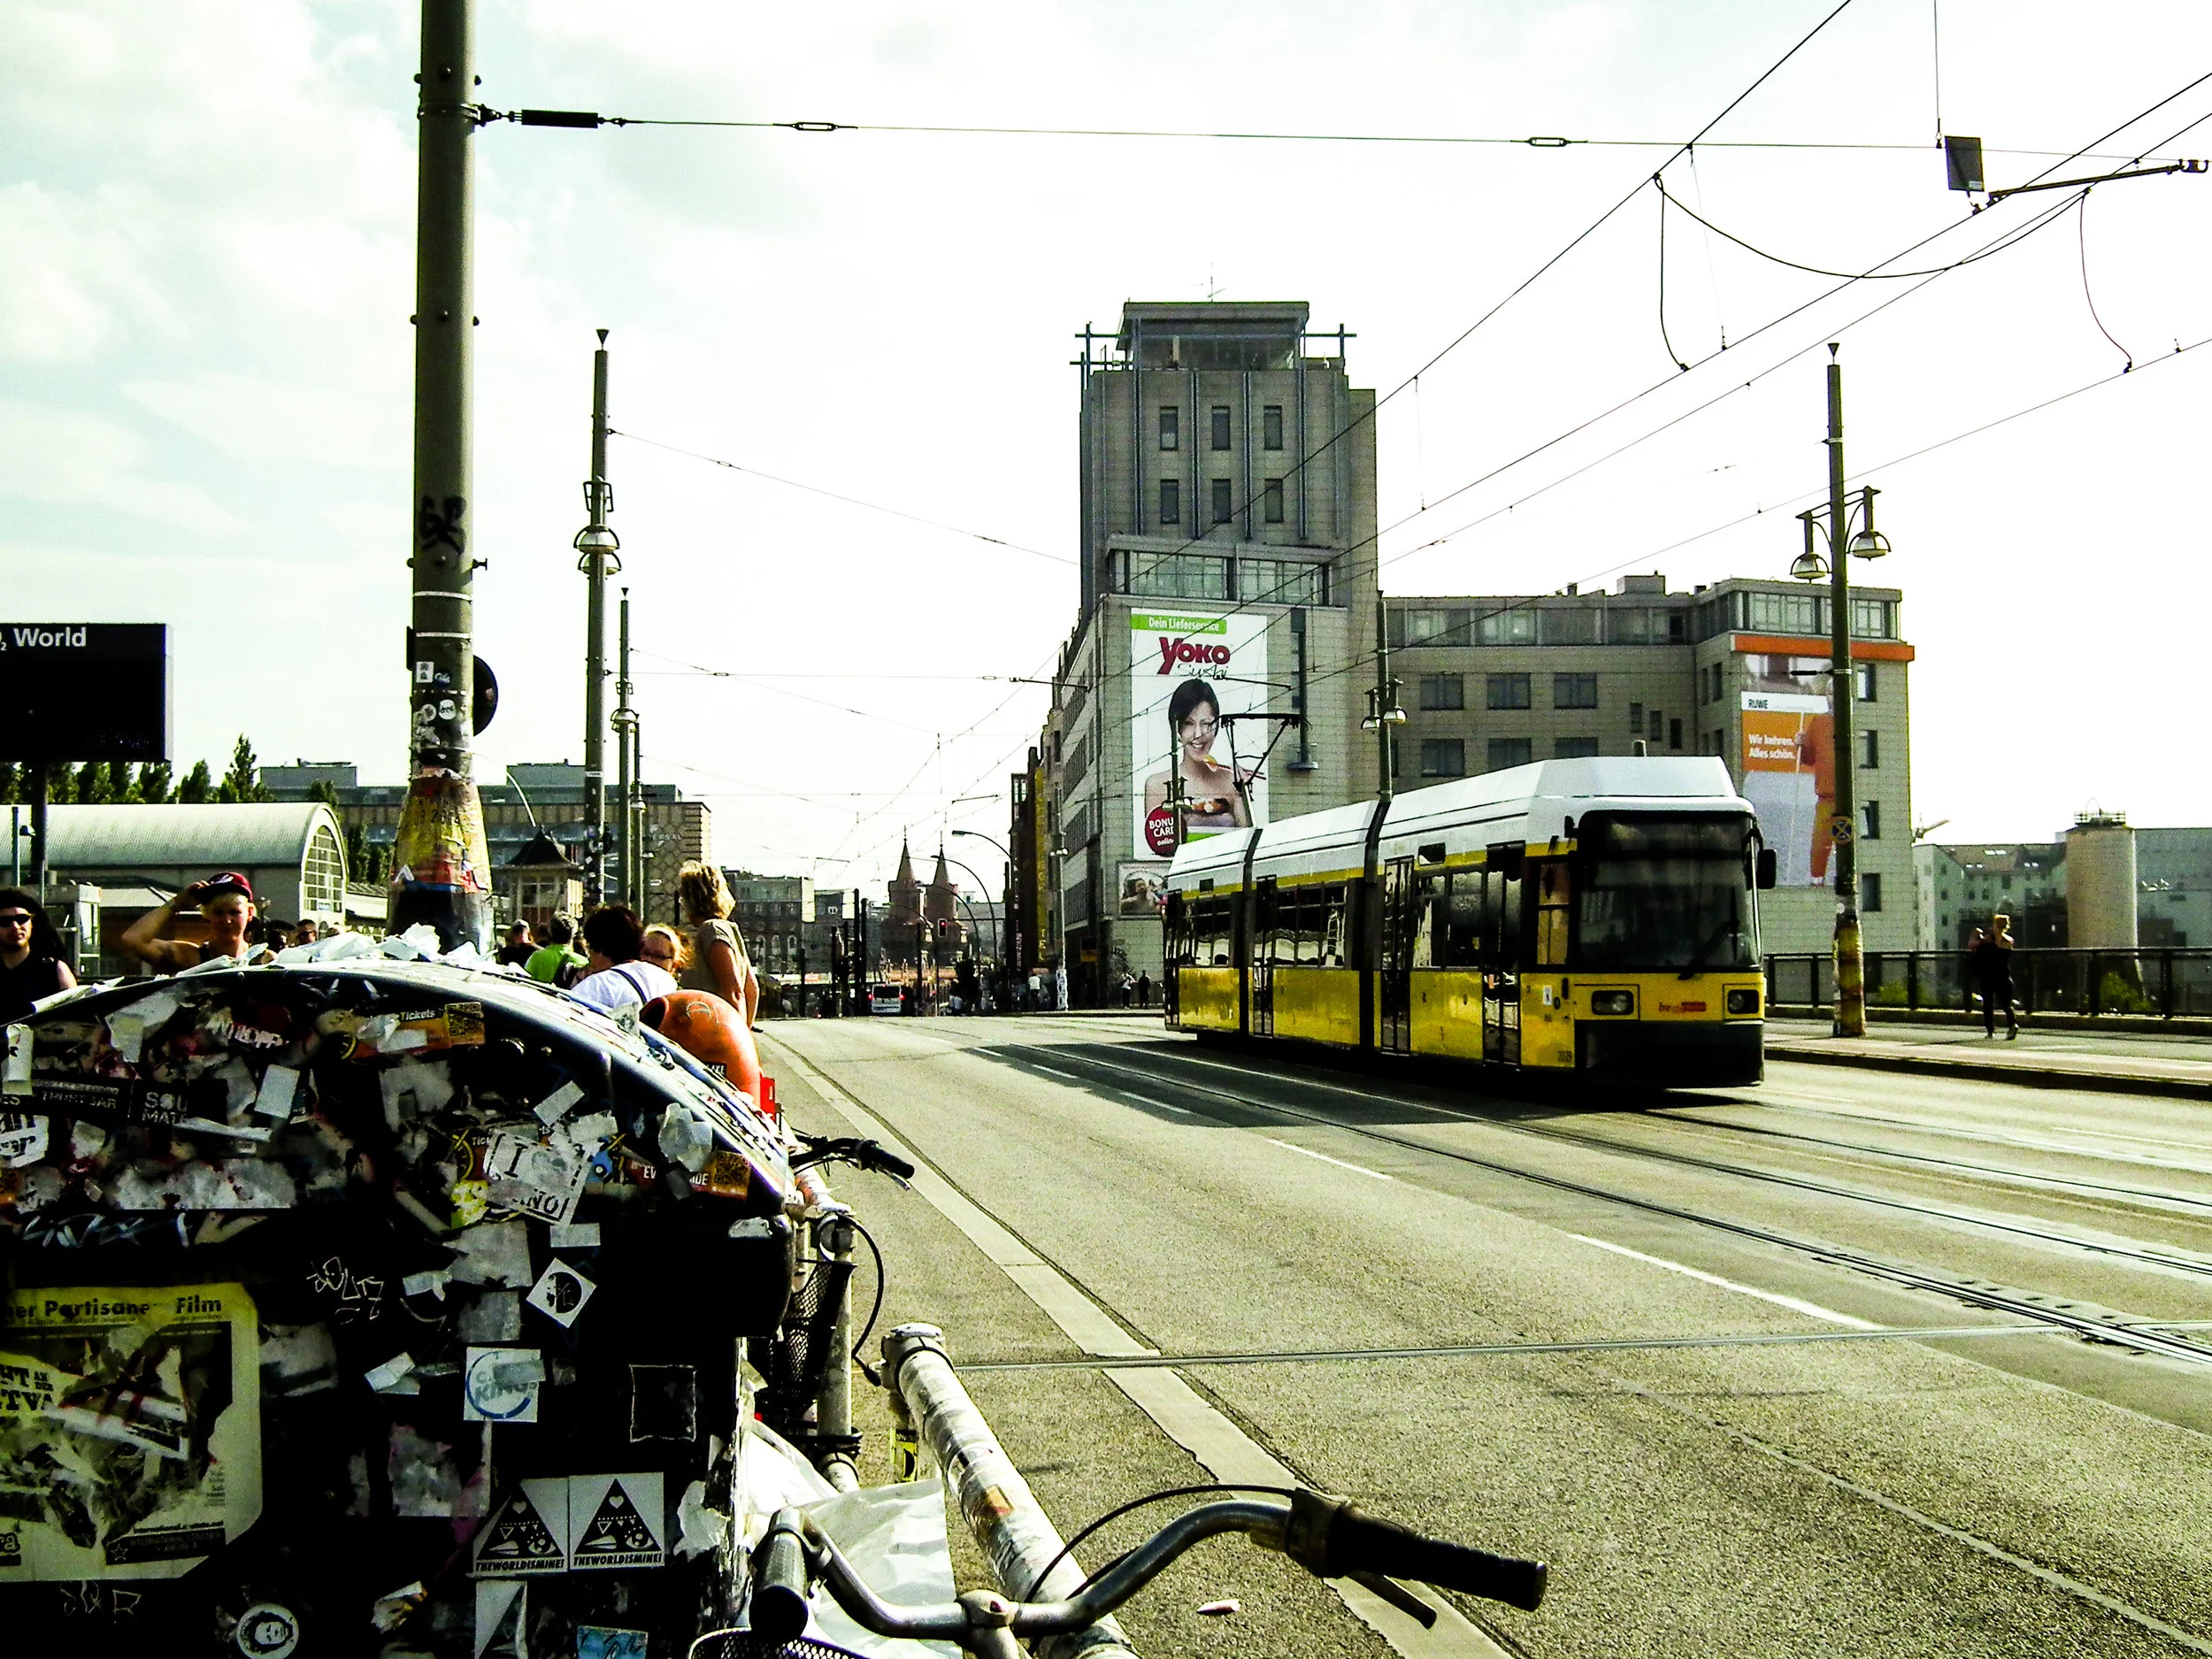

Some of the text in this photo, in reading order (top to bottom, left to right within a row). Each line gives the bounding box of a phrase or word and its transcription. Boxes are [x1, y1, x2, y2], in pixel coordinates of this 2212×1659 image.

[1148, 617, 1220, 632] Dein Lieferservice
[12, 626, 87, 647] World
[1177, 663, 1229, 679] Sushi
[1748, 698, 1769, 710] RUWE
[1748, 733, 1763, 745] Wir
[1748, 748, 1795, 759] Alles schön.
[1148, 817, 1174, 830] BONU
[1156, 837, 1175, 847] onlin
[400, 1009, 436, 1021] Tickets
[44, 1297, 151, 1319] Partisane
[176, 1294, 222, 1314] Film
